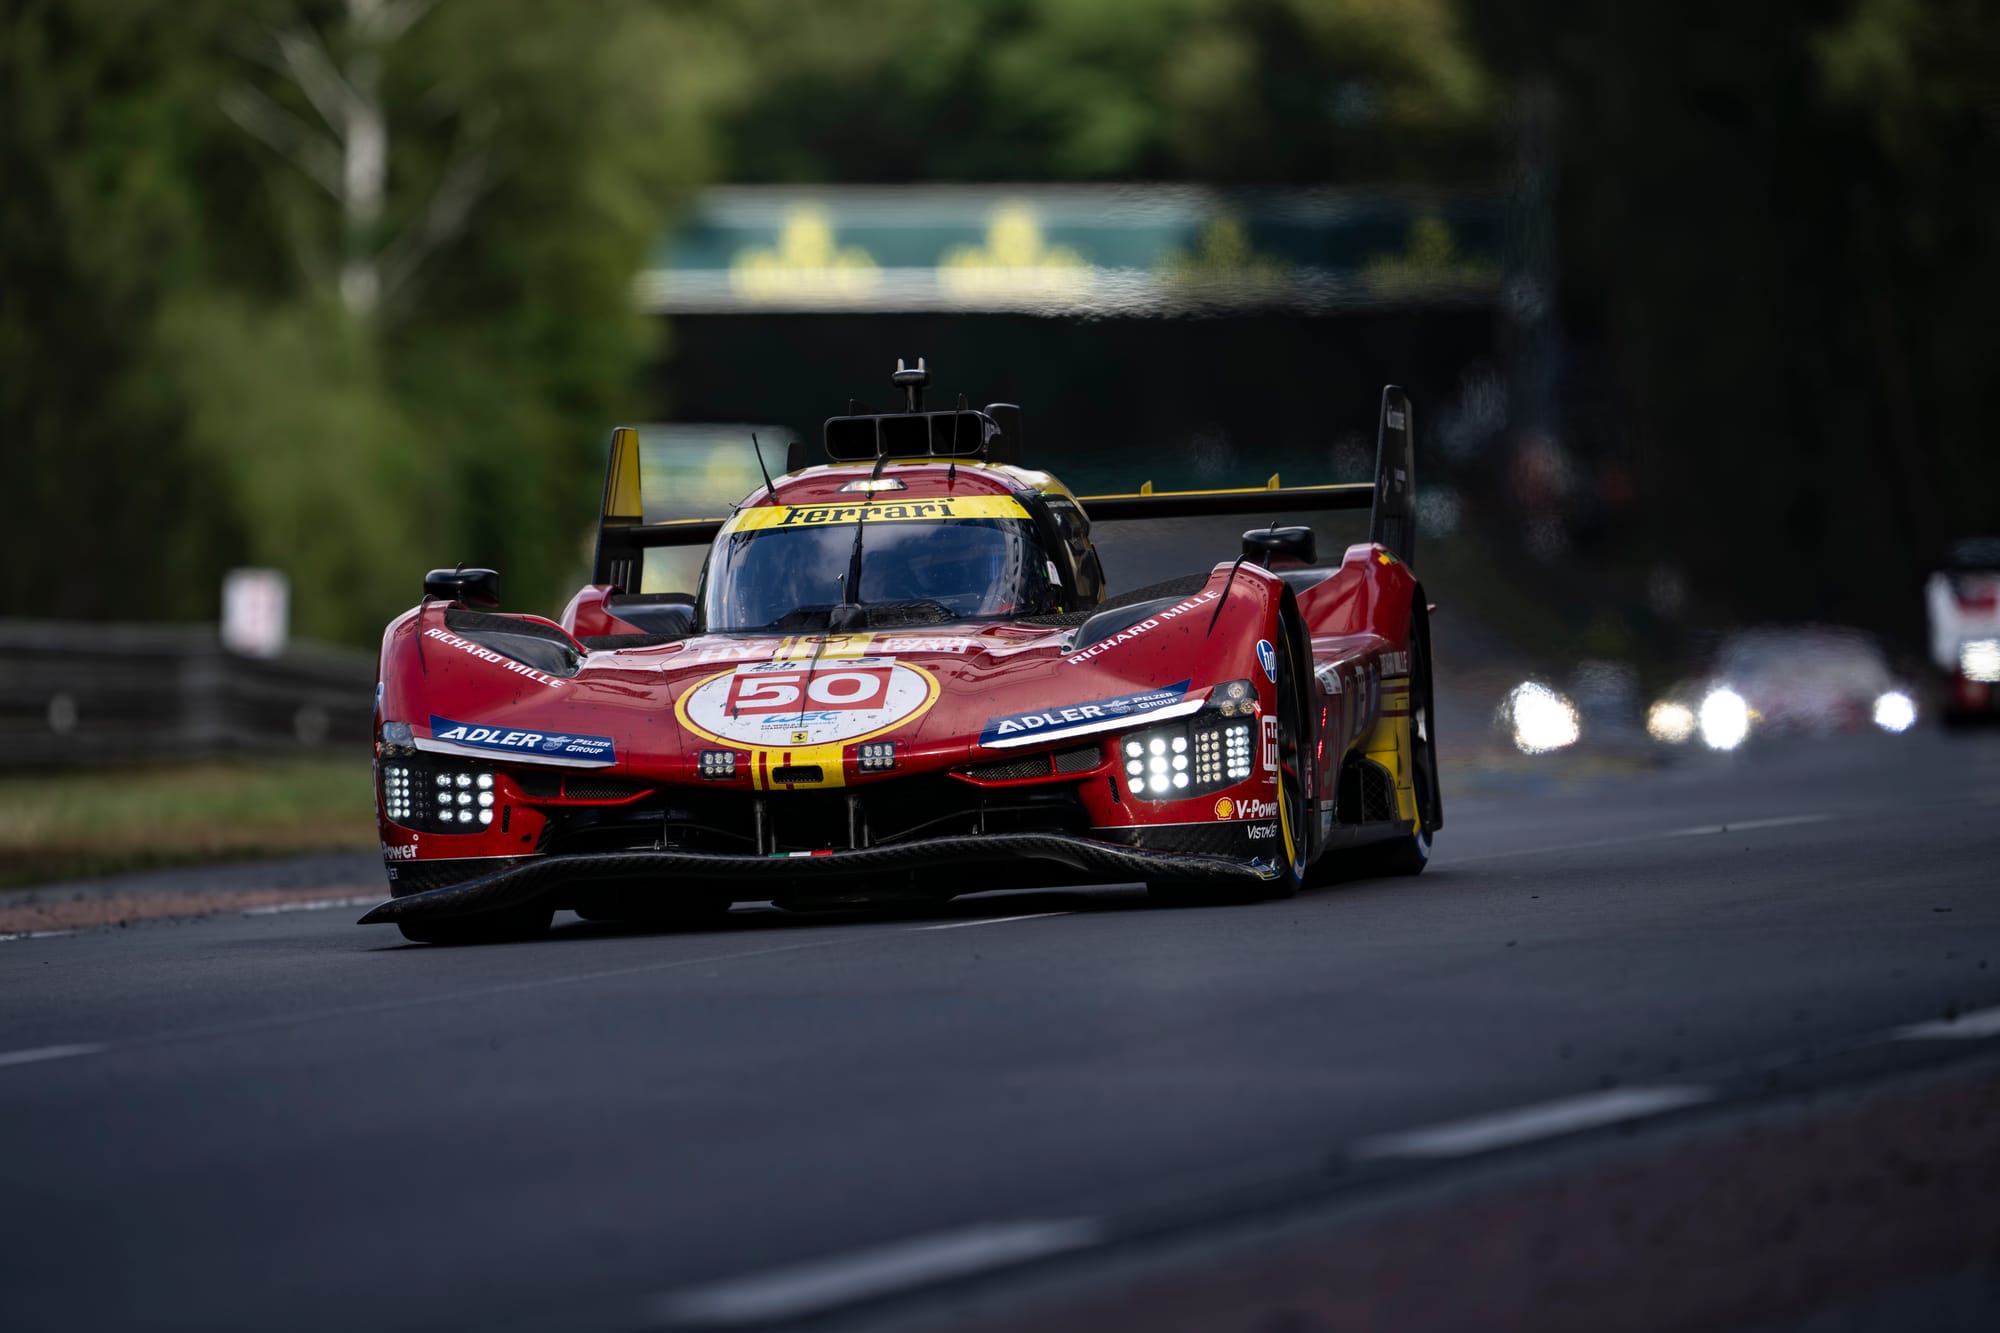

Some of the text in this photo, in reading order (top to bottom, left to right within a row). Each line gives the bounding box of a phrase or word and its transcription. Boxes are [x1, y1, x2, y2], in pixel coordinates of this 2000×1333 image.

[777, 498, 955, 525] Ferrari
[1067, 590, 1222, 665] RICHARD MILLE
[424, 628, 565, 688] RICHARD MILLE
[1259, 641, 1275, 680] hp
[735, 672, 880, 708] 50
[1137, 697, 1178, 709] GROUP
[762, 711, 842, 723] WEC
[997, 705, 1105, 735] ADLER
[437, 726, 543, 748] ADLER
[565, 744, 604, 754] GROUP
[572, 738, 611, 748] PELZER
